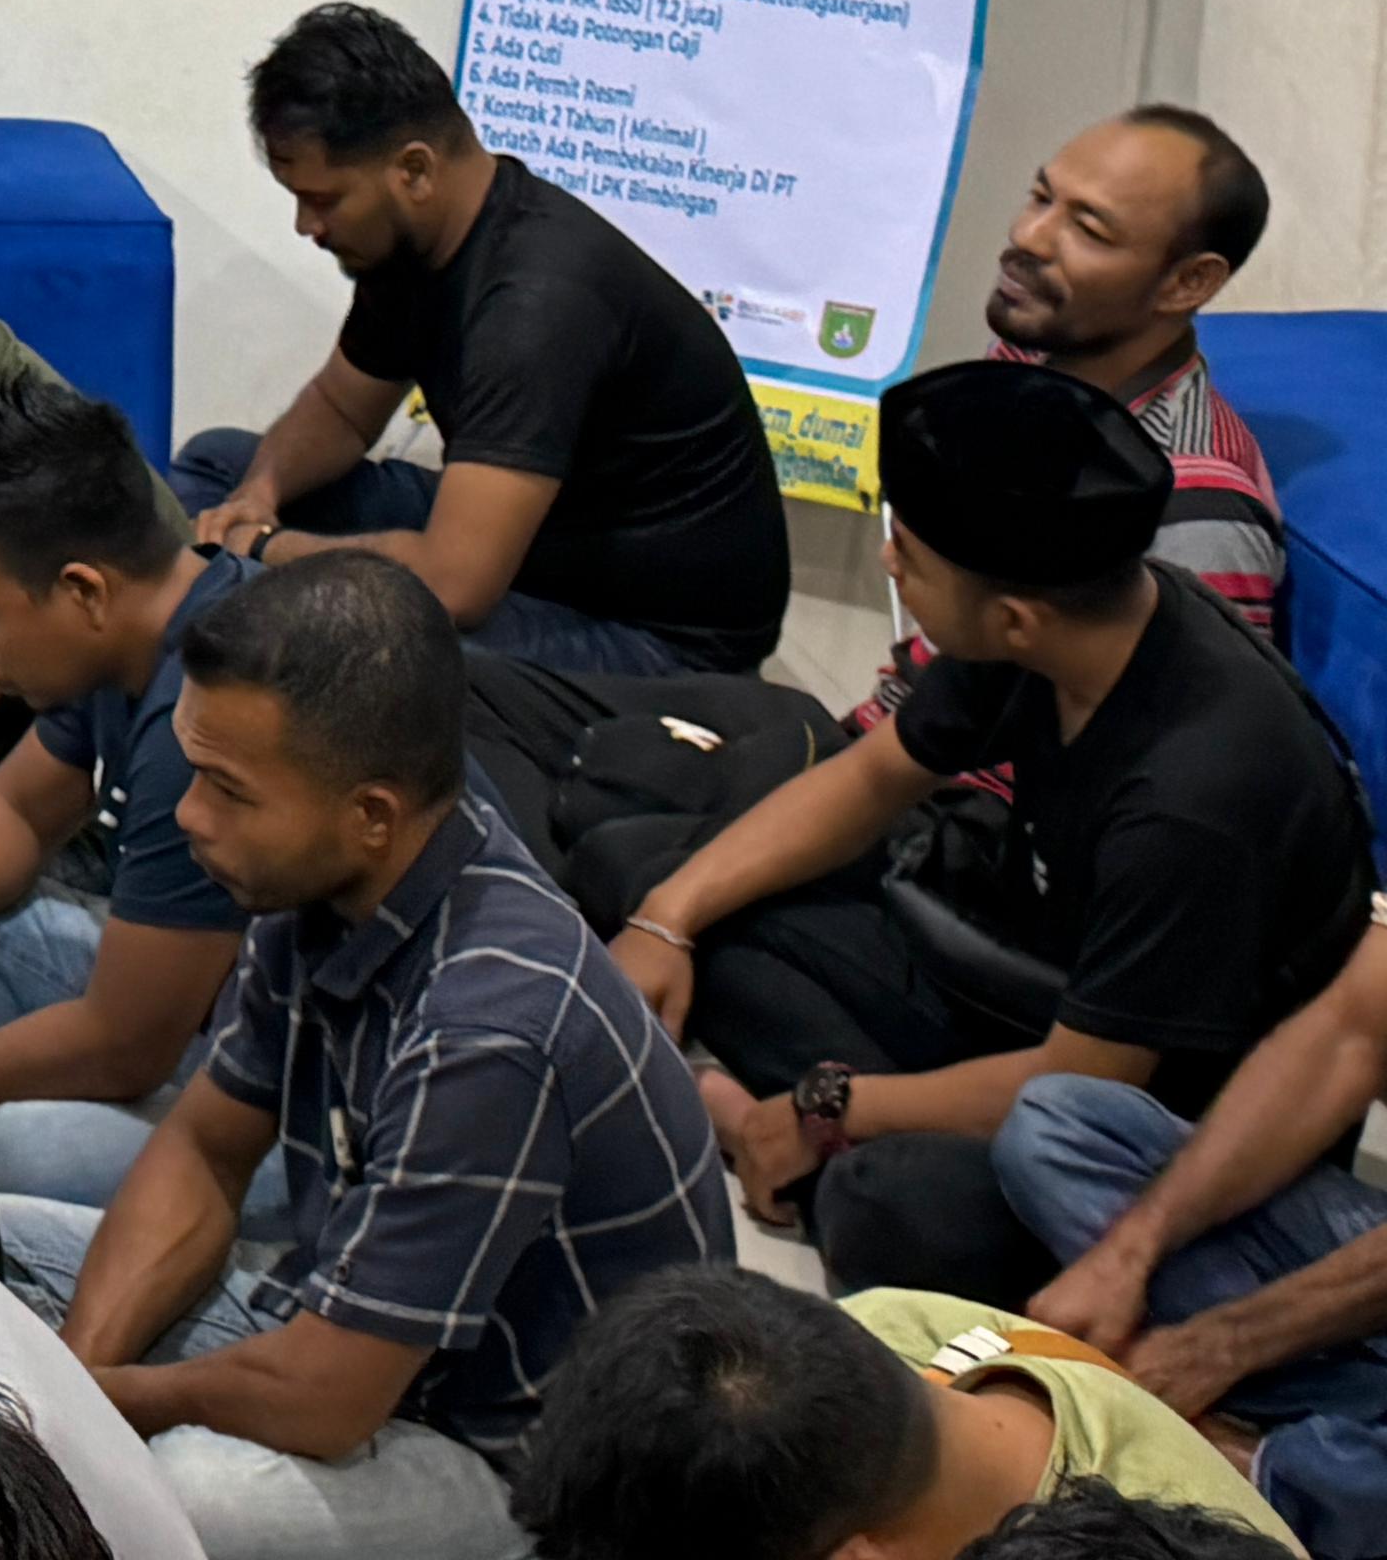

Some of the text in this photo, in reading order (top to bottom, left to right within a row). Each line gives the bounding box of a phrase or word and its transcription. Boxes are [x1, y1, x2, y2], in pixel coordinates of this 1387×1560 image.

[472, 30, 563, 65] 5. Ada Cuti
[477, 2, 702, 60] 4. Tidak Ada Potongan Gaji
[468, 61, 636, 107] 6. Ada Permit Resmi
[483, 94, 547, 125] Kontrak
[549, 104, 563, 127] 2
[566, 107, 616, 136] Tahun
[630, 118, 698, 149] Minimal
[545, 135, 577, 160] Ada
[582, 141, 685, 180] Pembekalan
[688, 159, 747, 192] Kinerja
[750, 168, 772, 194] Di
[774, 173, 798, 196] PT
[591, 174, 625, 200] LPK
